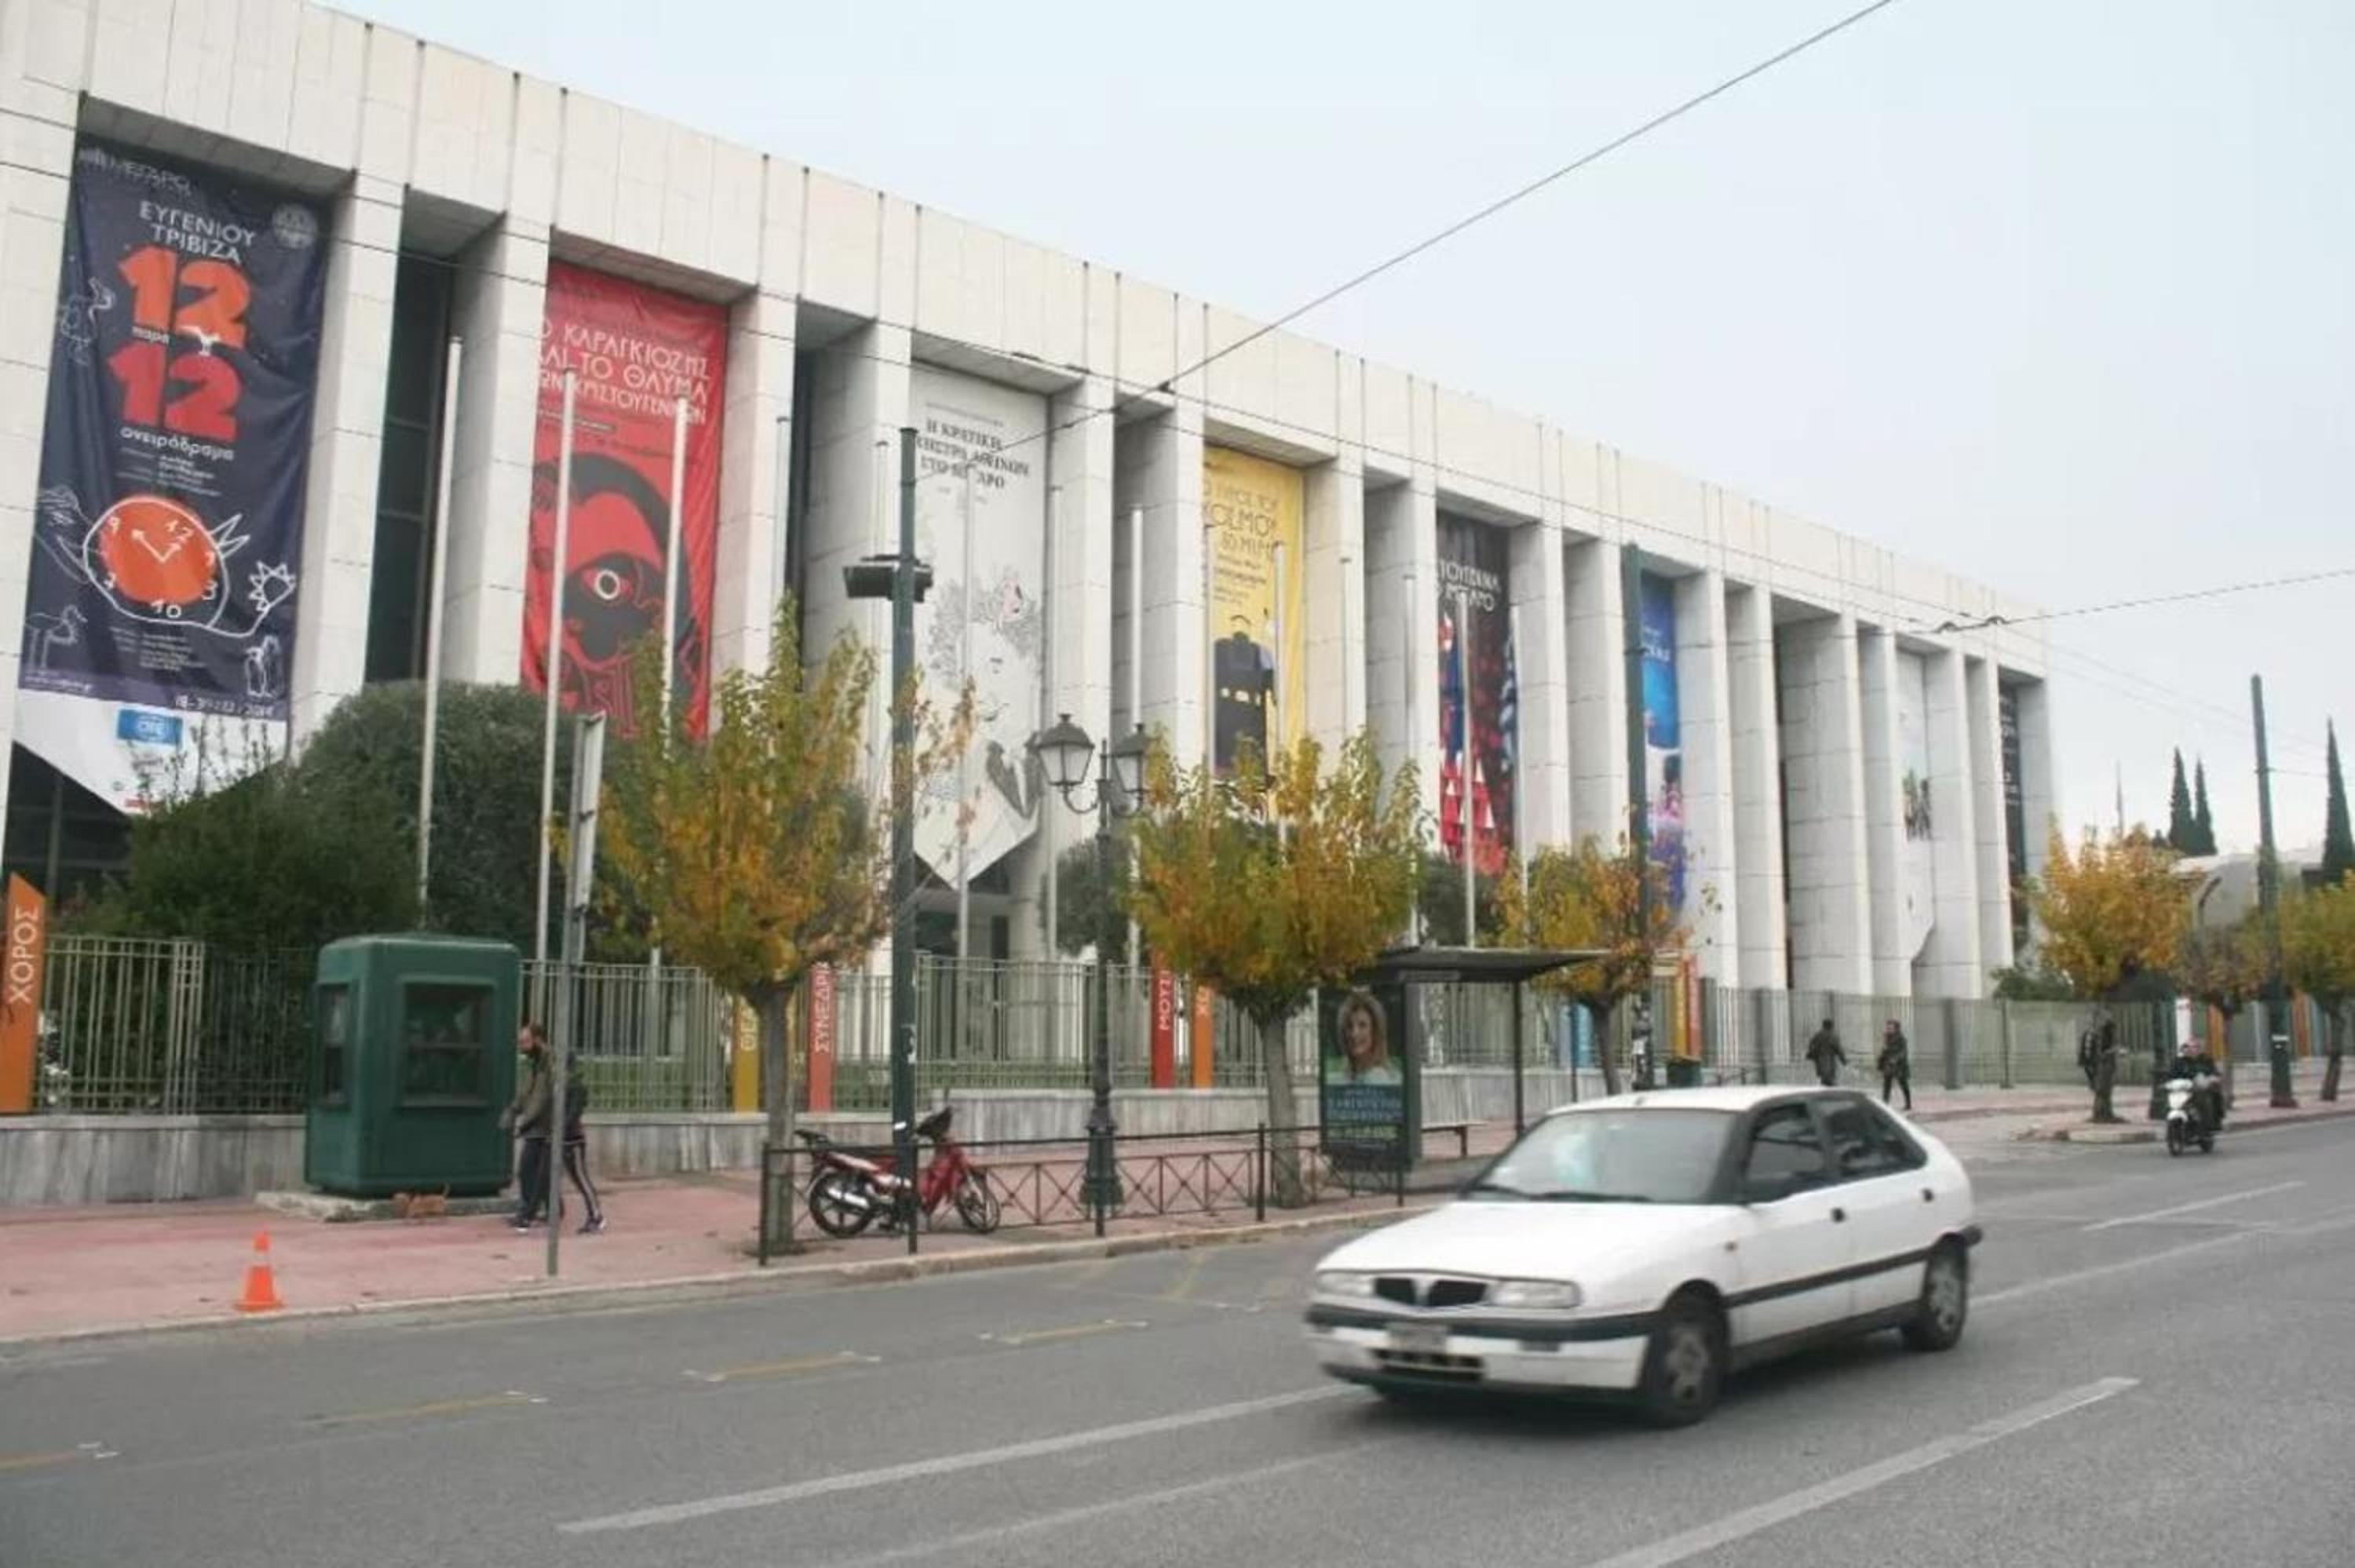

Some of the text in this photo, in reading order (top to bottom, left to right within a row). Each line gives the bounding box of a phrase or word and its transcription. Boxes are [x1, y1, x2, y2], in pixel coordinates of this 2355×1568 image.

[140, 201, 256, 247] ΕΥΓΕΝΙΟΥ
[152, 224, 241, 264] ΤΡΙΒΙΖΑ
[117, 244, 252, 350] 12
[579, 352, 615, 380] ΤΟ
[108, 341, 244, 443] 12
[151, 598, 182, 618] 10
[7, 903, 38, 1005] ΧΟΡΟΣ
